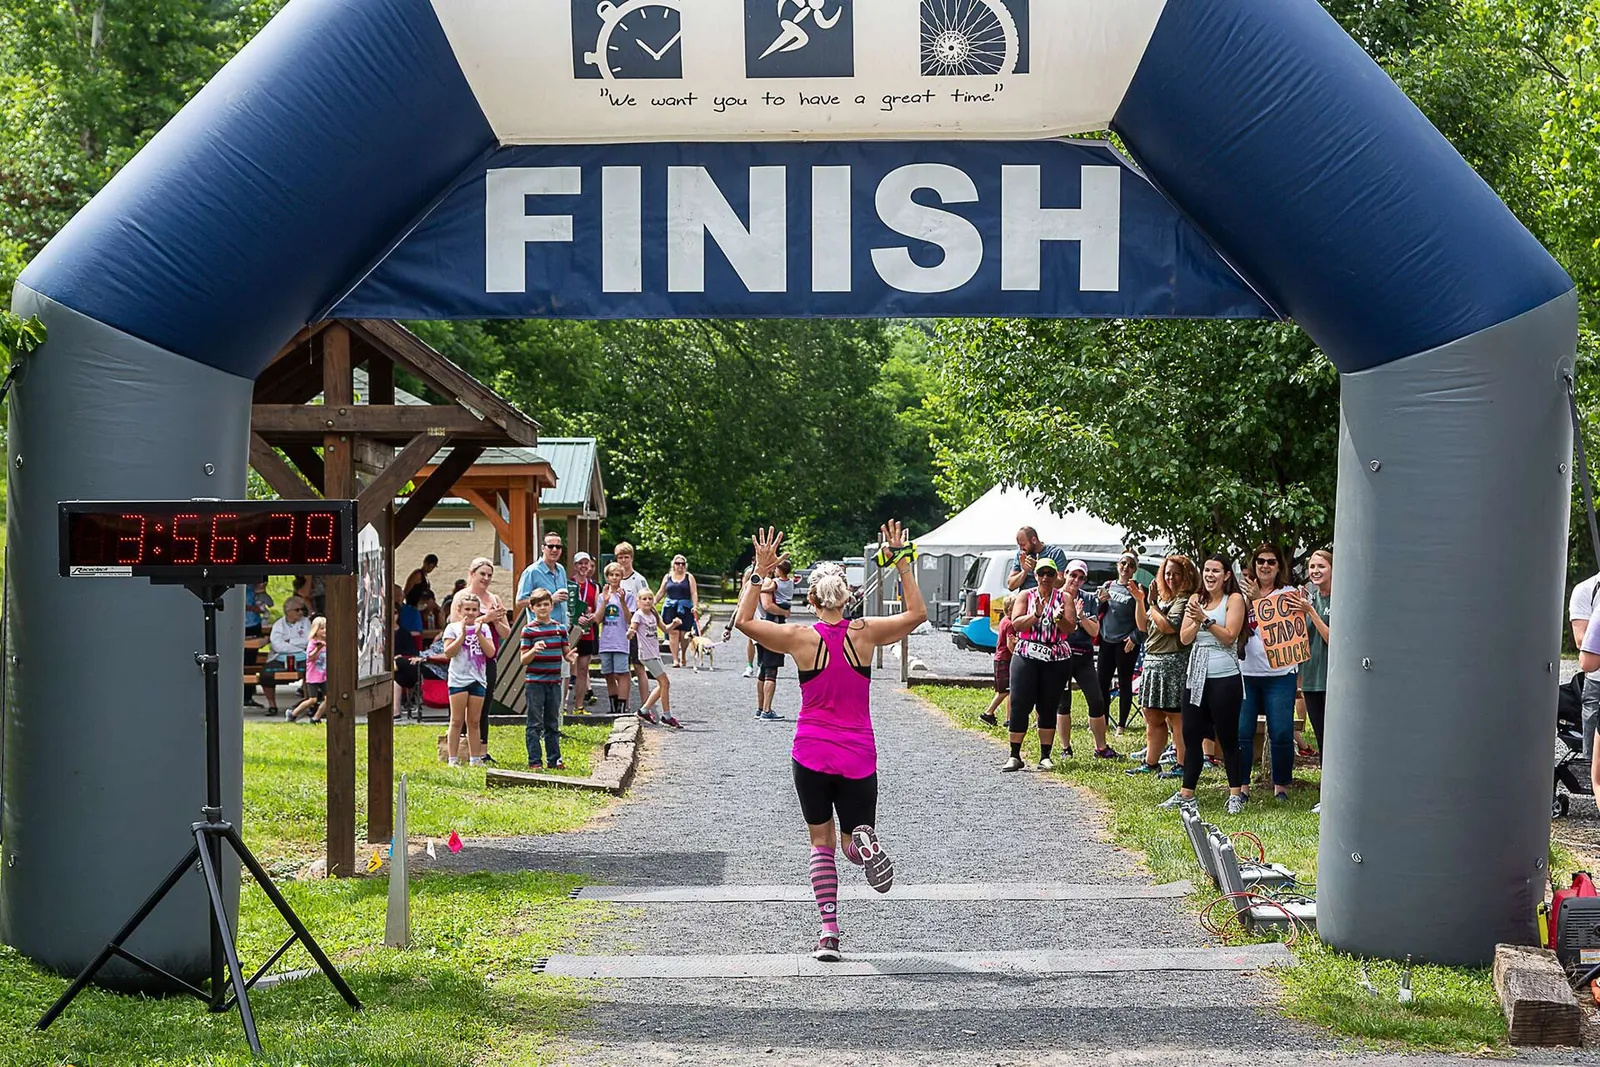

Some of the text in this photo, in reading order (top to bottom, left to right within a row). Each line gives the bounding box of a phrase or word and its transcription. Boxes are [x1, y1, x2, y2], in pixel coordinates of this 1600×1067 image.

[651, 92, 698, 106] want
[713, 96, 748, 112] you
[761, 91, 786, 106] to
[799, 92, 841, 106] have
[854, 95, 866, 104] a
[880, 89, 936, 111] great
[486, 163, 1121, 294] FINISH
[1266, 640, 1311, 669] PLUCK
